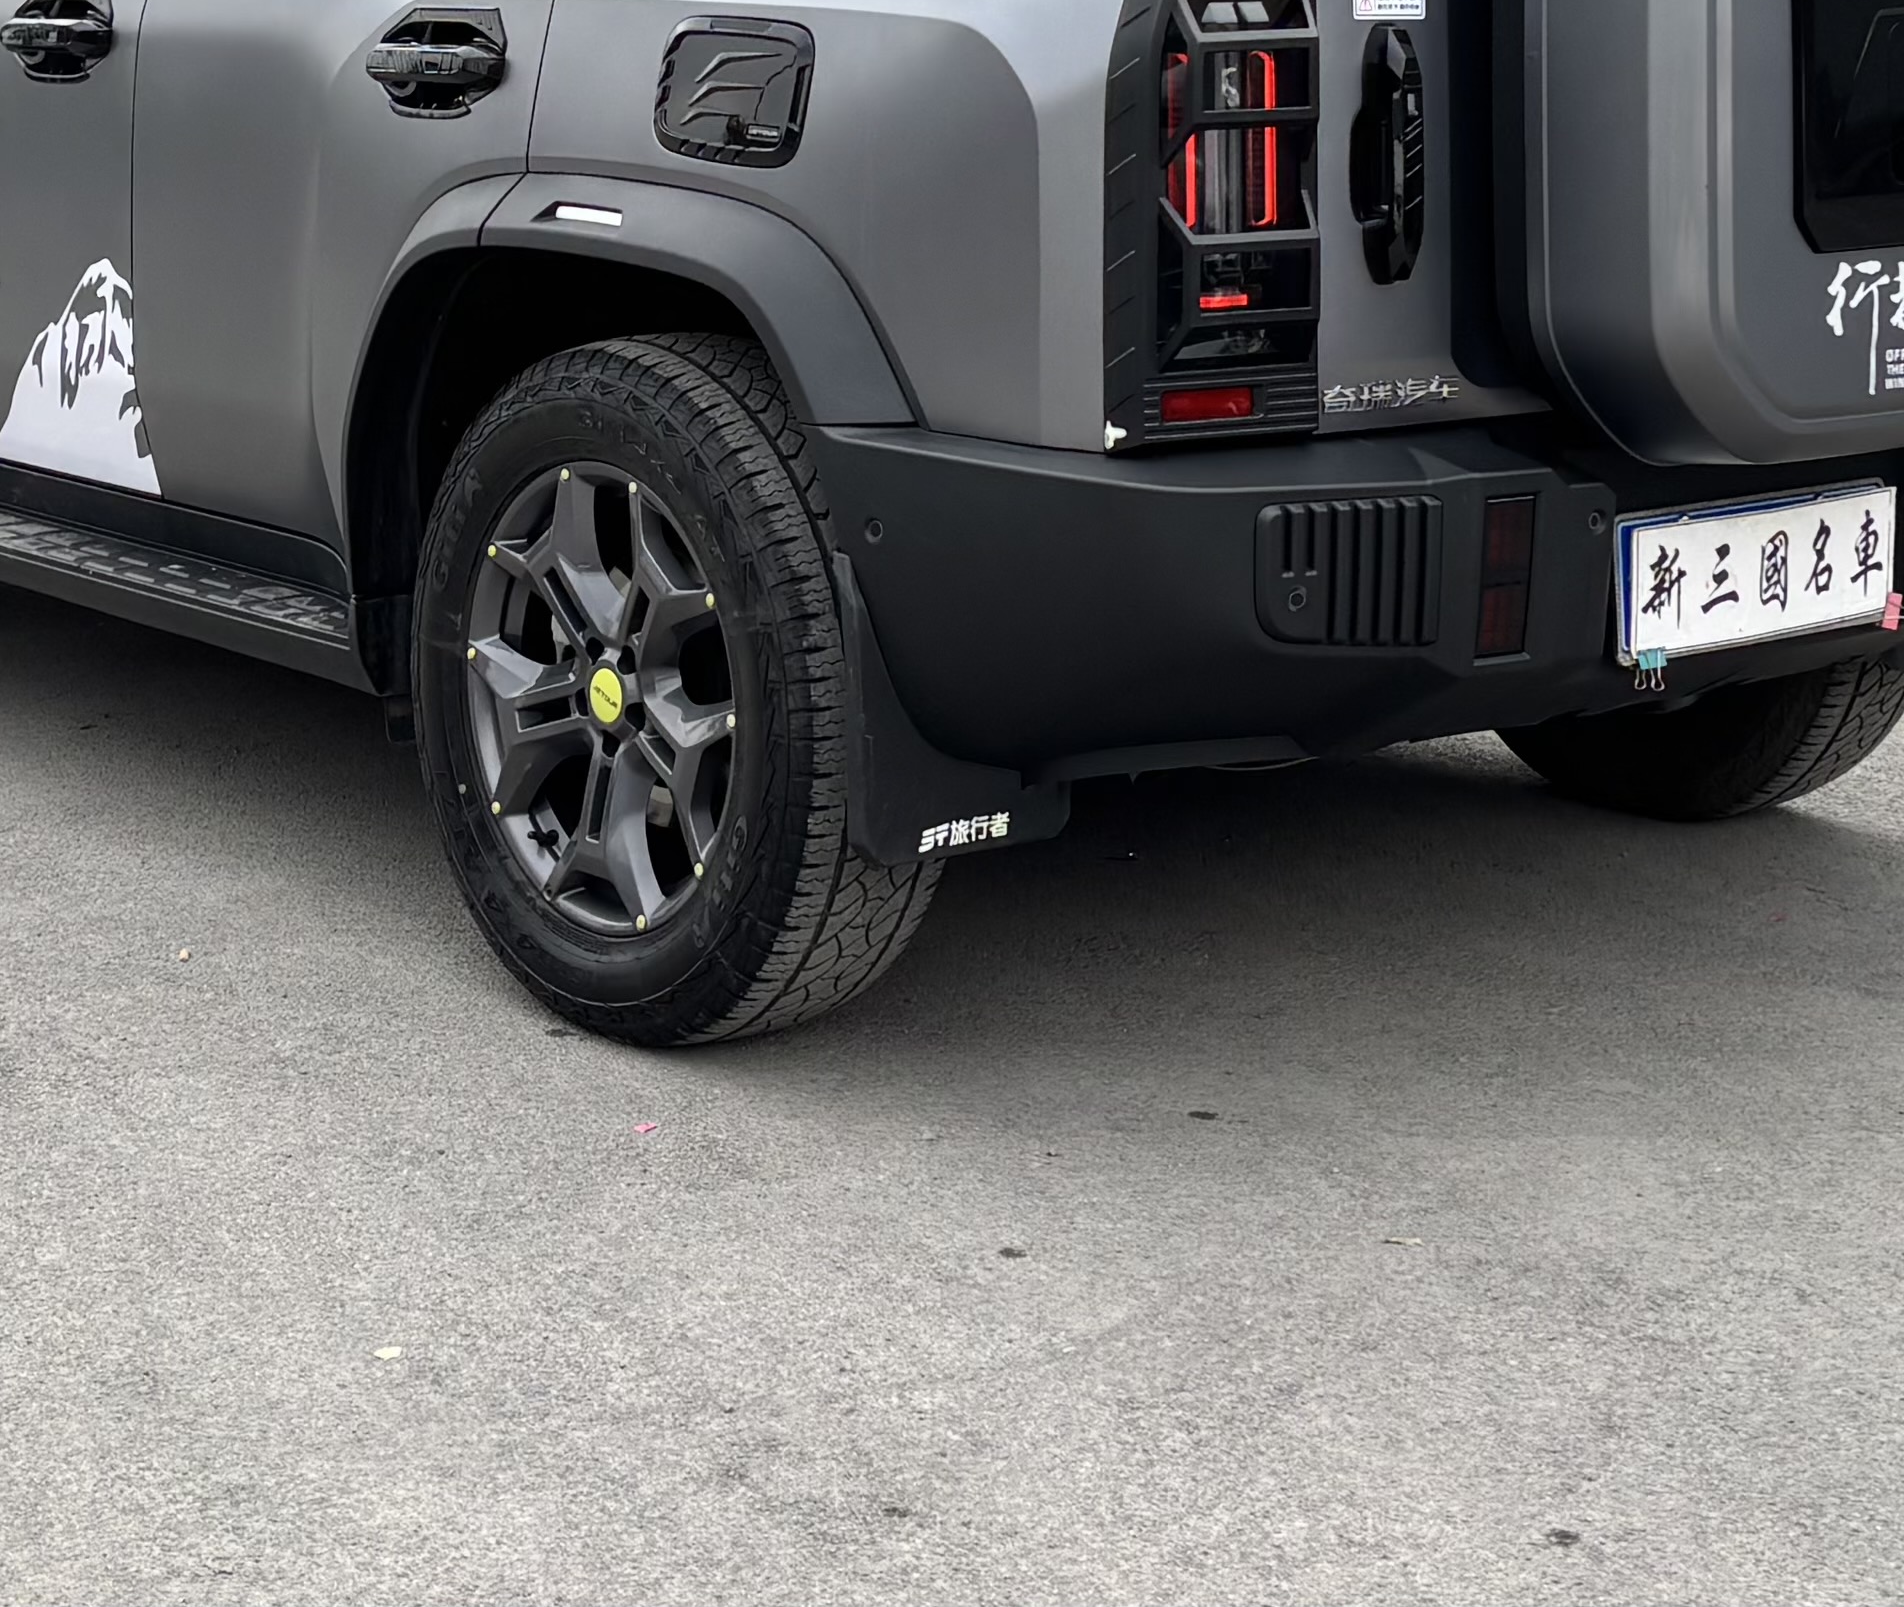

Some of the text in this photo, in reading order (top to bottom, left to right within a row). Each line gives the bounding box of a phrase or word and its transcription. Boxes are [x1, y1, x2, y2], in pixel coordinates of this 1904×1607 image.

[1323, 374, 1460, 412] 奇瑞汽车
[1641, 508, 1884, 630] 新三國名車
